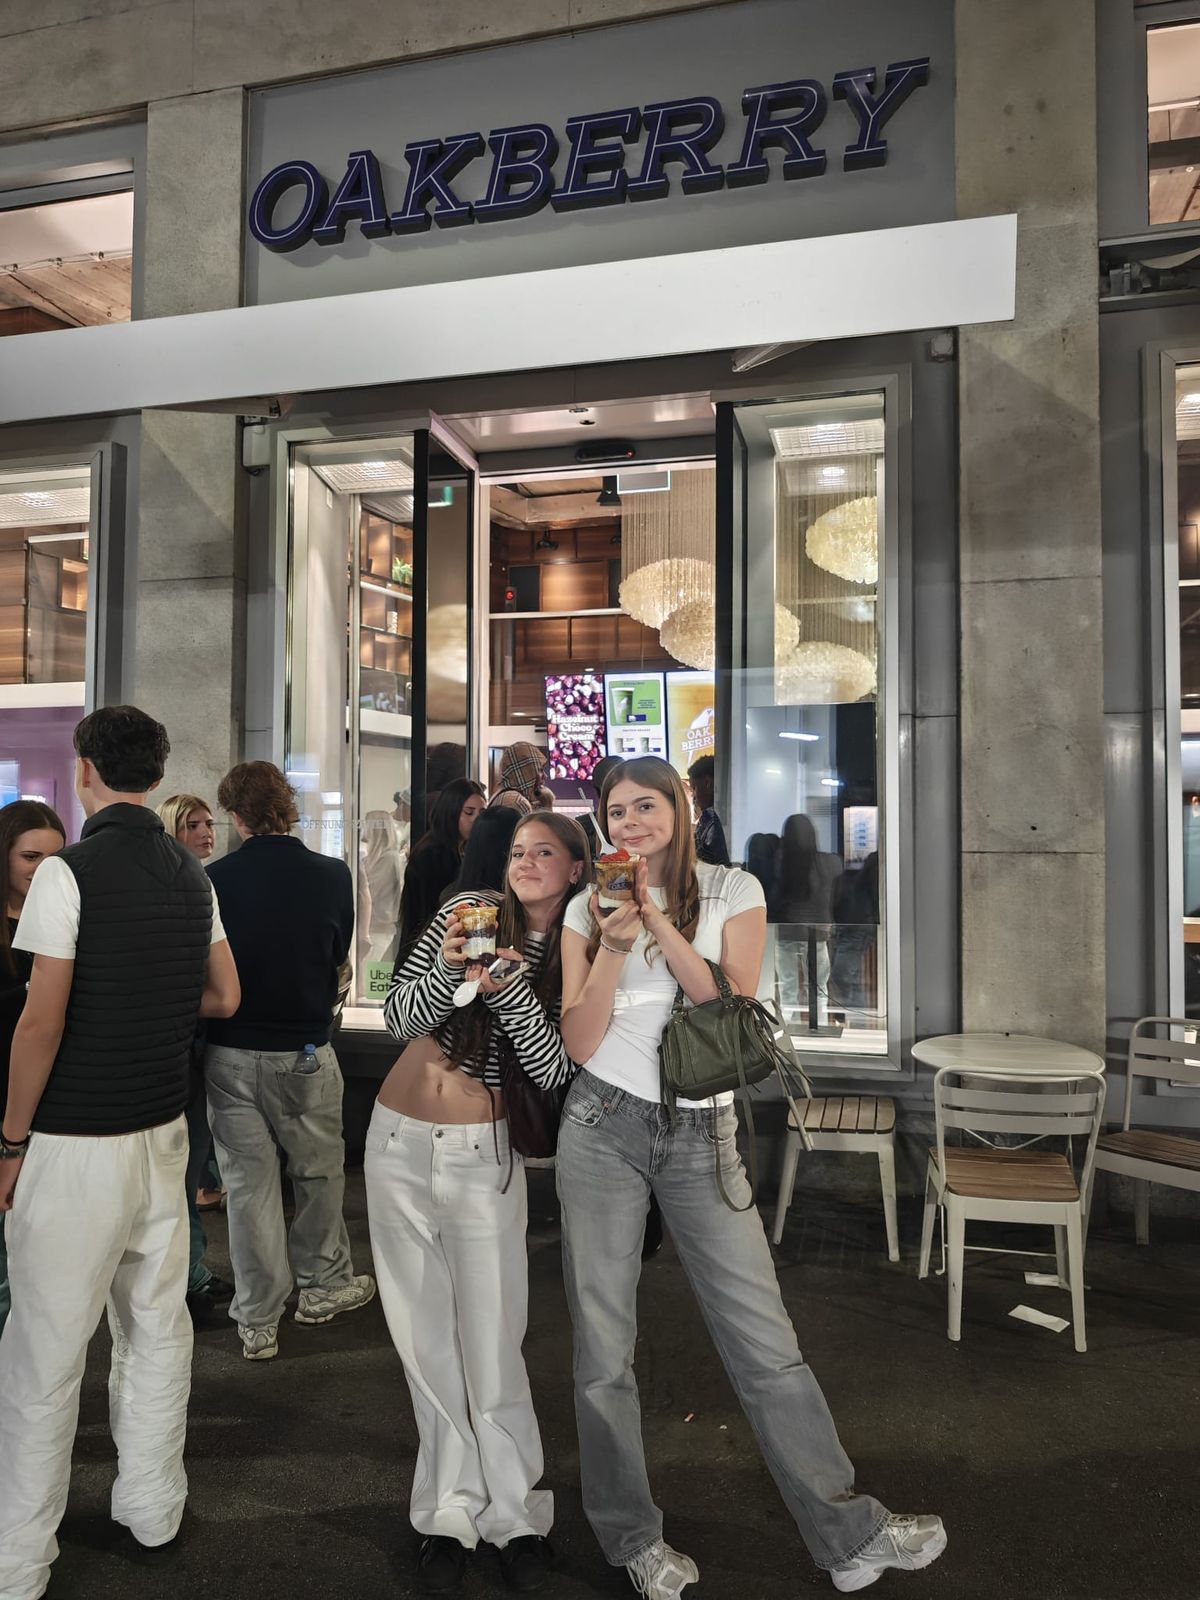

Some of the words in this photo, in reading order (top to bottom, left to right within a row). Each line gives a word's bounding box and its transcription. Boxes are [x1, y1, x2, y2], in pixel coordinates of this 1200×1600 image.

[249, 57, 930, 252] OAKBERRY
[552, 714, 599, 724] Hazelnut
[559, 723, 593, 732] Choco
[688, 727, 711, 739] OAK
[558, 732, 595, 741] Cream
[370, 969, 393, 980] Ube
[370, 981, 391, 992] Eat
